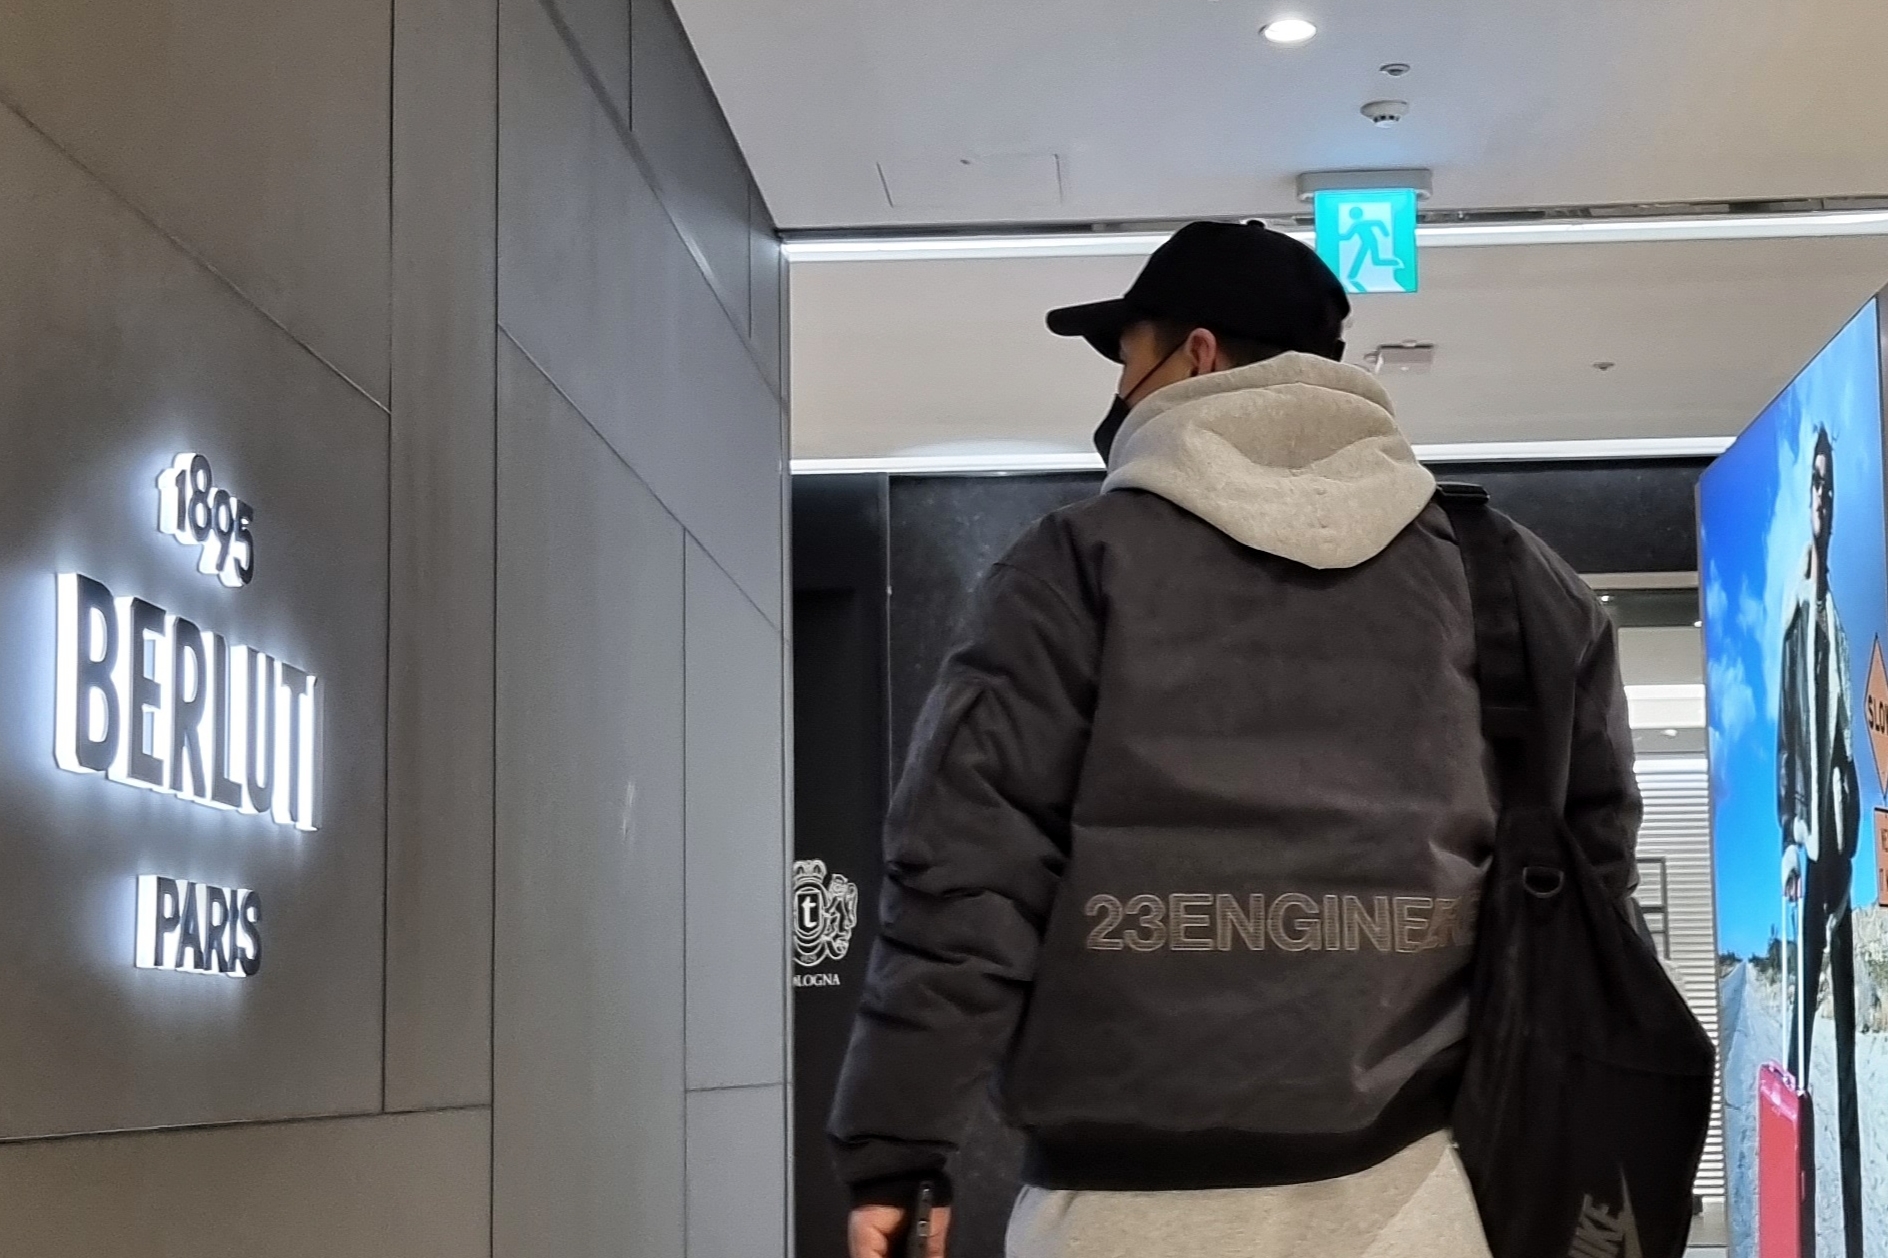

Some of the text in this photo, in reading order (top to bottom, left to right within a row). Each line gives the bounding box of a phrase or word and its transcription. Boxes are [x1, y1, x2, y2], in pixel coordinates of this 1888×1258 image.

[157, 452, 255, 587] 1895
[55, 572, 324, 831] BERLUTI
[135, 875, 262, 978] PARIS
